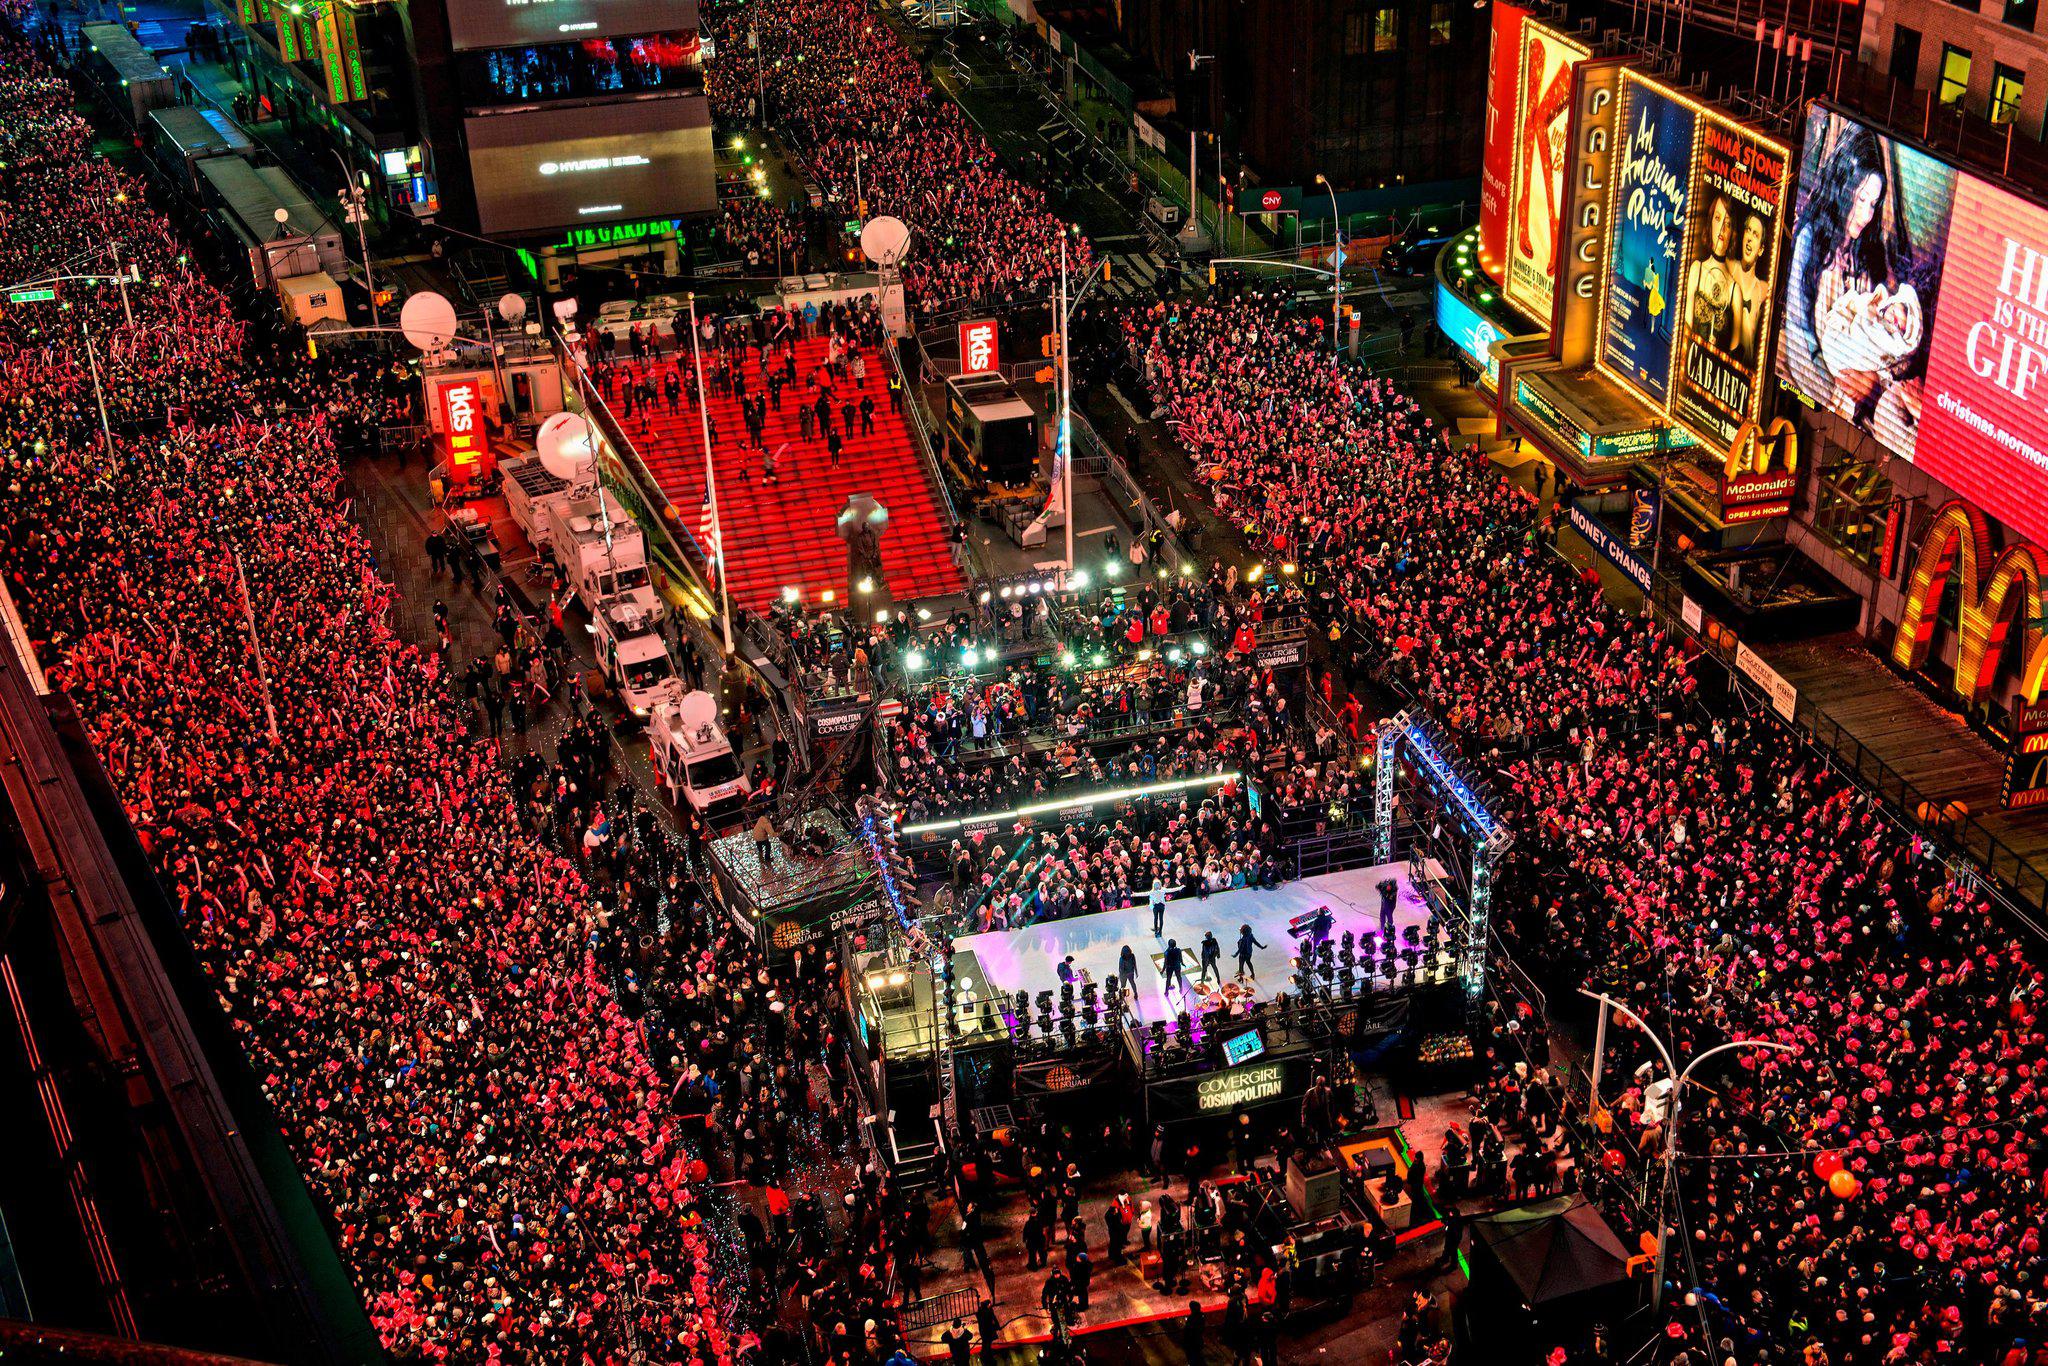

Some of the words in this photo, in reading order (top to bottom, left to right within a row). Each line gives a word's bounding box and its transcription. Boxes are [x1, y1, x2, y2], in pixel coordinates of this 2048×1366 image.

[328, 53, 343, 102] GARDEN
[1635, 106, 1654, 154] An
[1705, 126, 1740, 161] EMMA
[1743, 146, 1783, 181] STONE
[1576, 88, 1611, 299] PALACE
[1621, 133, 1684, 225] American
[1702, 152, 1728, 178] ALAN
[1730, 167, 1778, 205] CUMMING
[1714, 174, 1722, 189] 12
[1723, 179, 1750, 204] WEEKS
[1751, 195, 1774, 217] ONLY
[1262, 196, 1282, 206] CNY
[1627, 188, 1668, 245] Paris
[1993, 297, 2015, 329] IS
[970, 325, 993, 371] tkts
[1966, 320, 2048, 413] GIF
[1687, 341, 1748, 415] CABARET
[449, 385, 475, 432] tkts
[1601, 432, 1651, 446] TEMPTATIONS
[1726, 479, 1795, 495] McDonald's
[1736, 489, 1782, 501] Restaurant
[1728, 511, 1749, 519] OPEN
[1751, 509, 1761, 517] 24
[1763, 506, 1789, 515] HOURS
[1570, 506, 1608, 548] MONEY
[1608, 541, 1651, 591] CHANGE
[817, 713, 861, 727] COSMOPOLITAN
[785, 928, 810, 941] TIMES
[790, 931, 824, 946] SQUARE
[1198, 1067, 1282, 1094] COVERGIRL
[1199, 1080, 1282, 1109] COSMOPOLITAN
